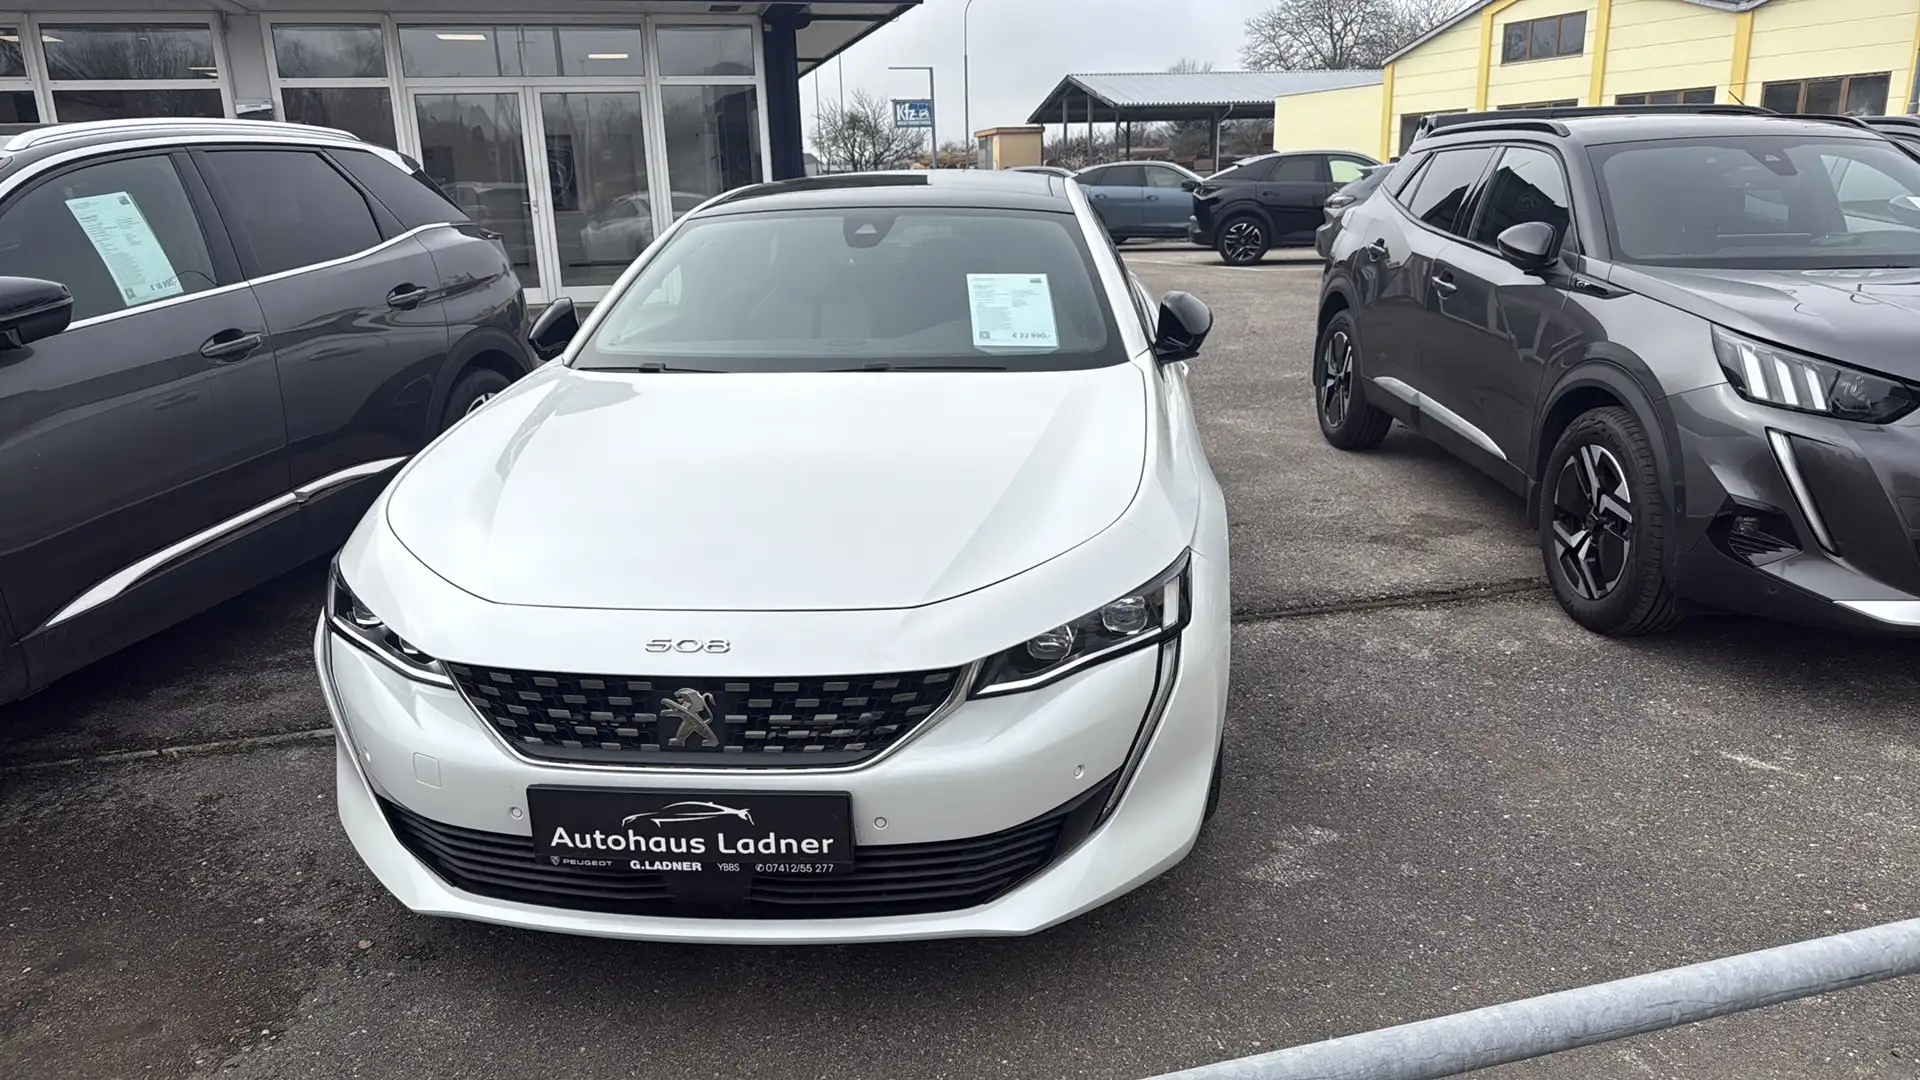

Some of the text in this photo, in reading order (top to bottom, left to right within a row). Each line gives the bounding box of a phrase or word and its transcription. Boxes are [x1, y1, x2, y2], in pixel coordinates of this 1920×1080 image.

[896, 103, 917, 120] Kfz
[645, 639, 732, 654] 508
[550, 826, 834, 854] Autohaus Ladner
[563, 858, 613, 867] PEUGEOT
[630, 860, 702, 872] G.LADNER
[717, 862, 740, 872] YBBS
[815, 863, 834, 873] 277
